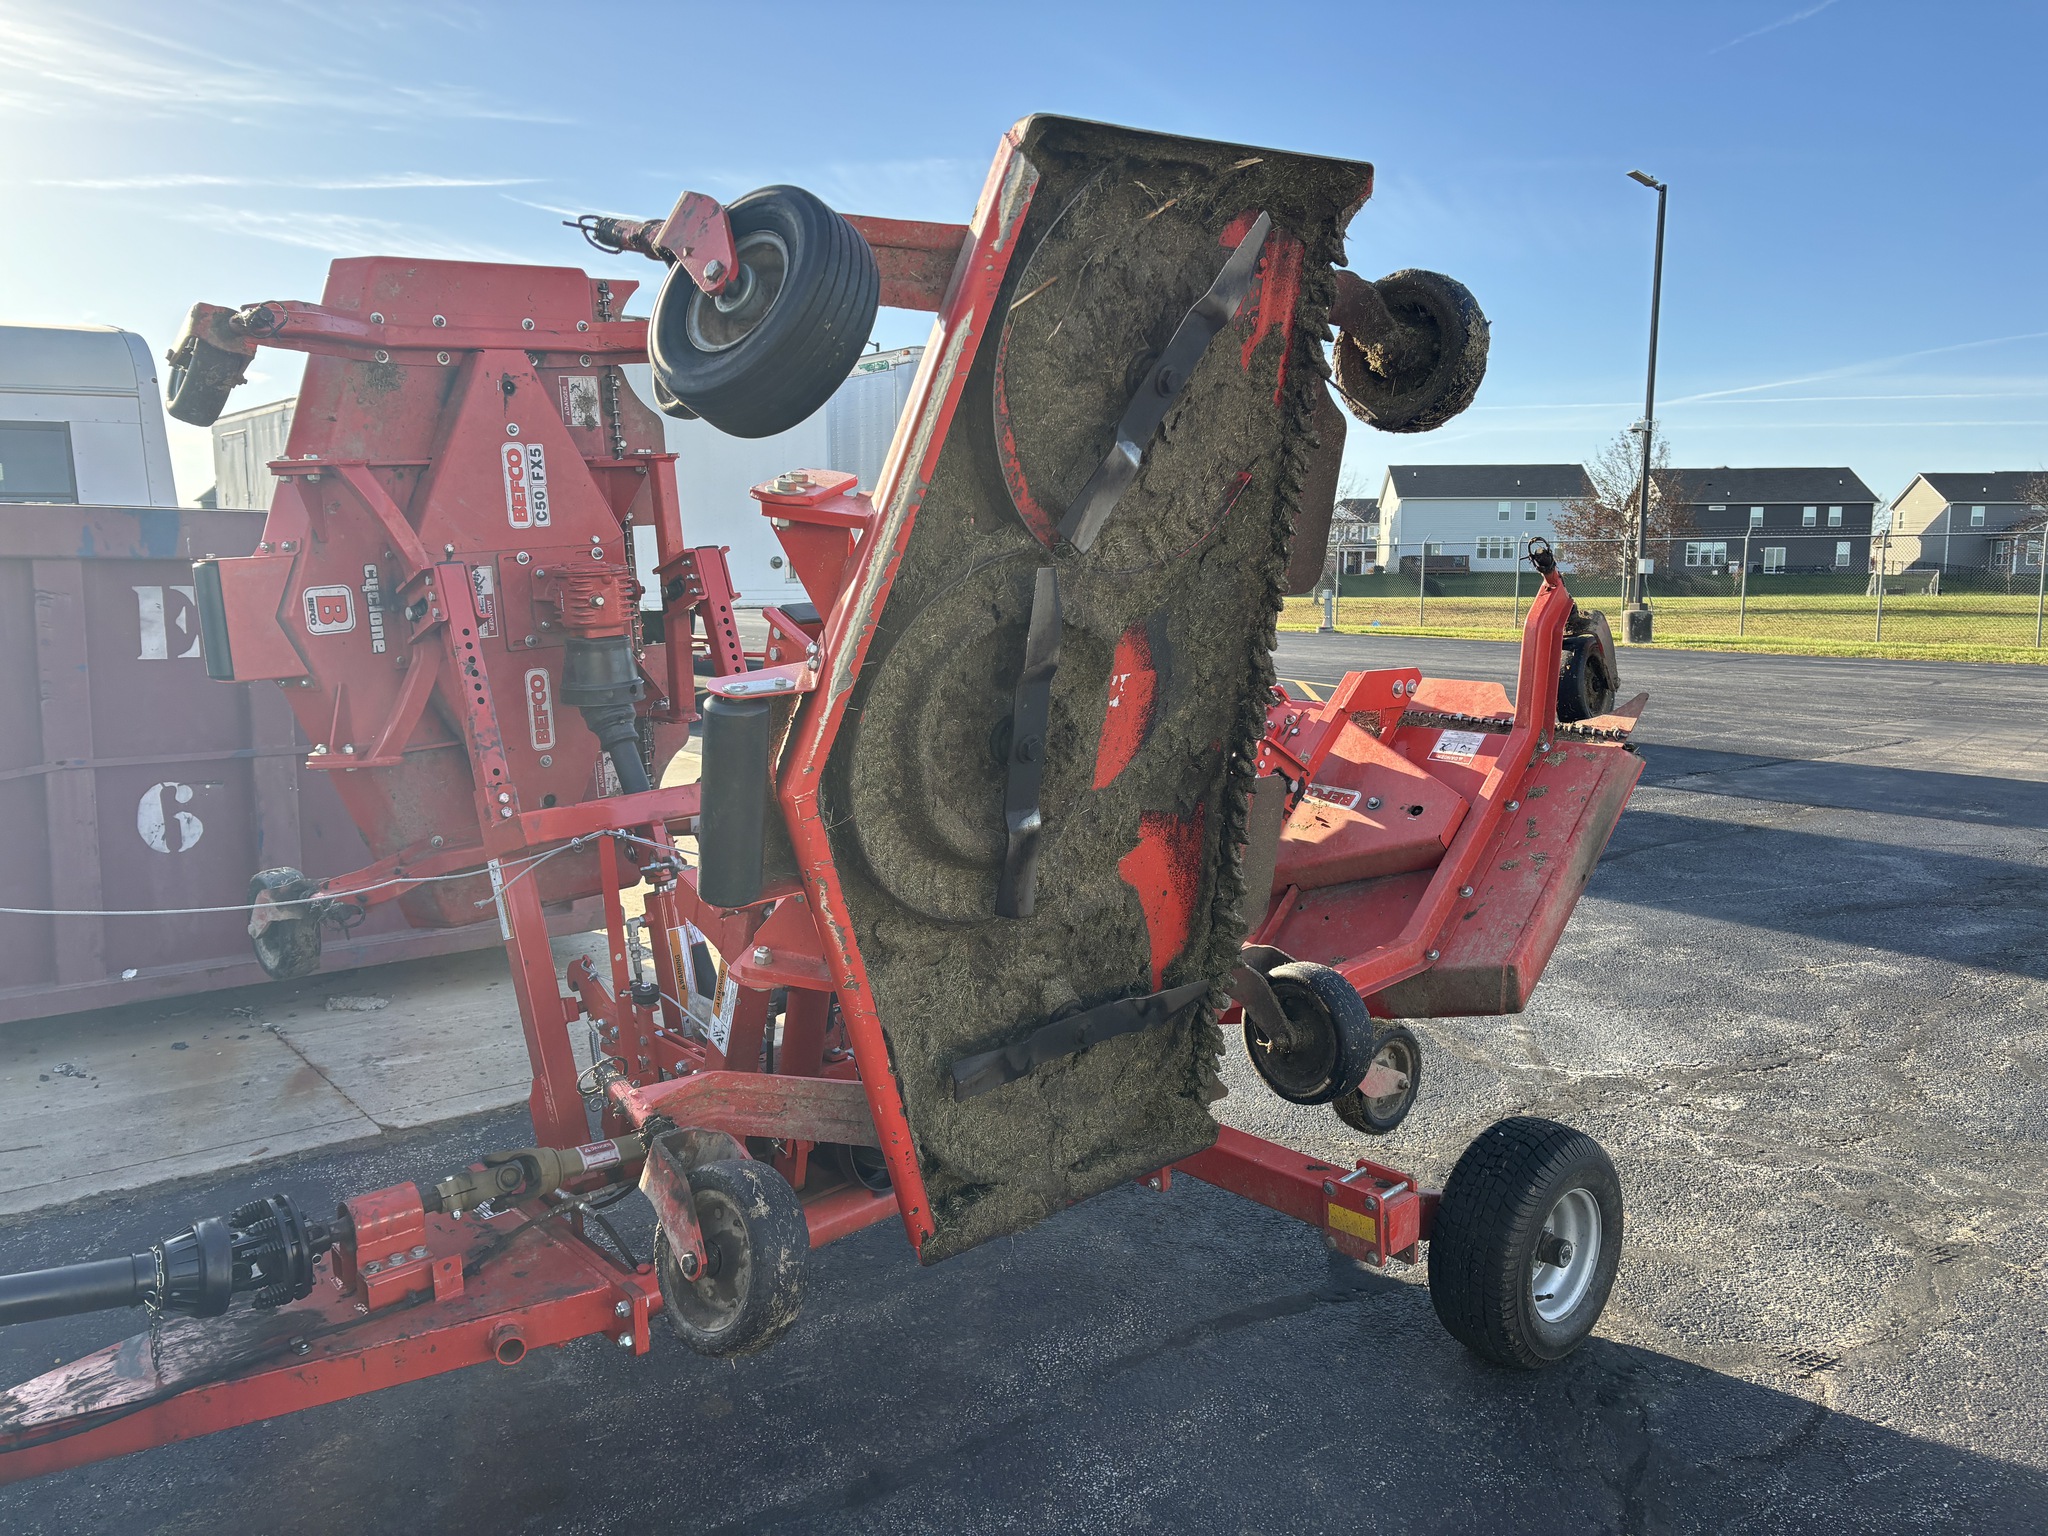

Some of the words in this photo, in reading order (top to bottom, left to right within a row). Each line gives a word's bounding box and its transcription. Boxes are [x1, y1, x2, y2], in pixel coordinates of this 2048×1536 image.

[563, 385, 571, 411] DANGER
[530, 447, 545, 481] FX5
[507, 448, 528, 523] BEFCO
[534, 490, 548, 522] C50
[307, 597, 317, 626] BEFCO
[316, 595, 348, 625] B
[360, 563, 386, 654] cyclone
[530, 674, 551, 745] BEFCO
[137, 781, 204, 854] 6
[675, 954, 685, 985] WARNING
